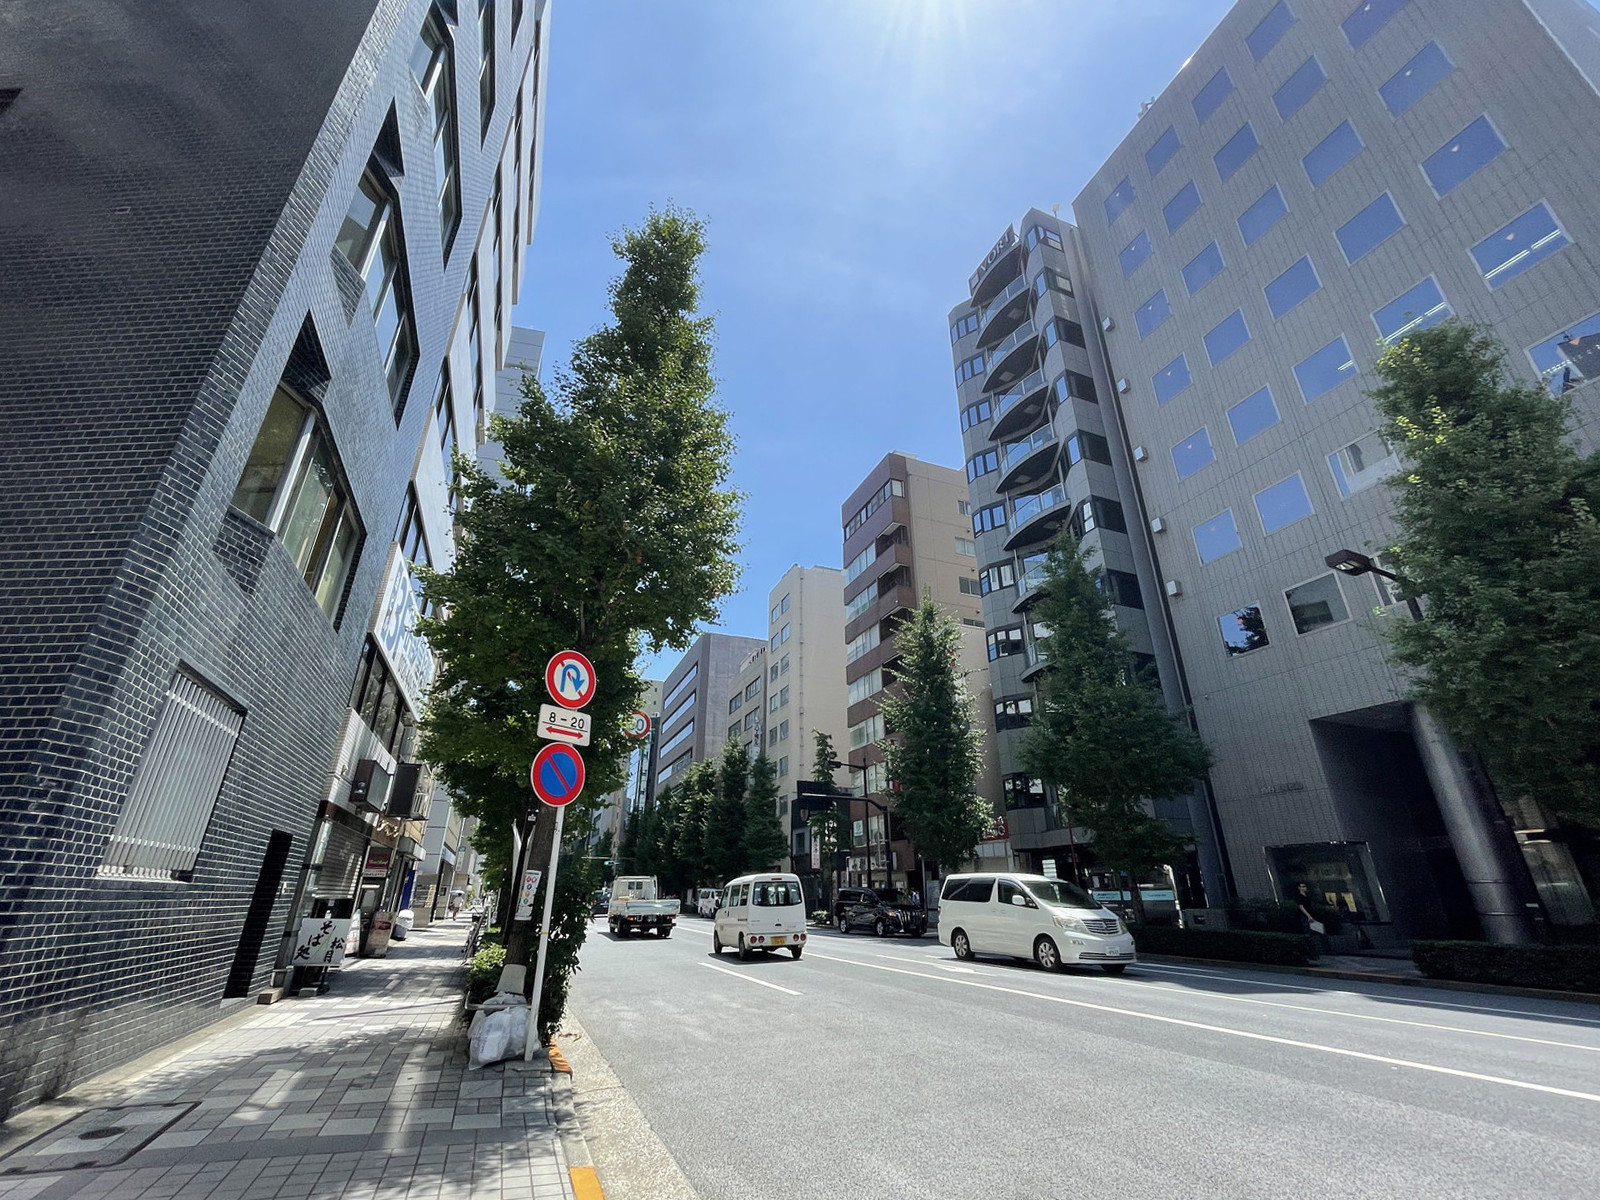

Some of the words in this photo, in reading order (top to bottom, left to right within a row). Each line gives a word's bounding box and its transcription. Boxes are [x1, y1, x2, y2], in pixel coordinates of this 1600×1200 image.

[980, 231, 1011, 271] VORT
[294, 920, 333, 961] そば処
[322, 936, 346, 964] 松月
